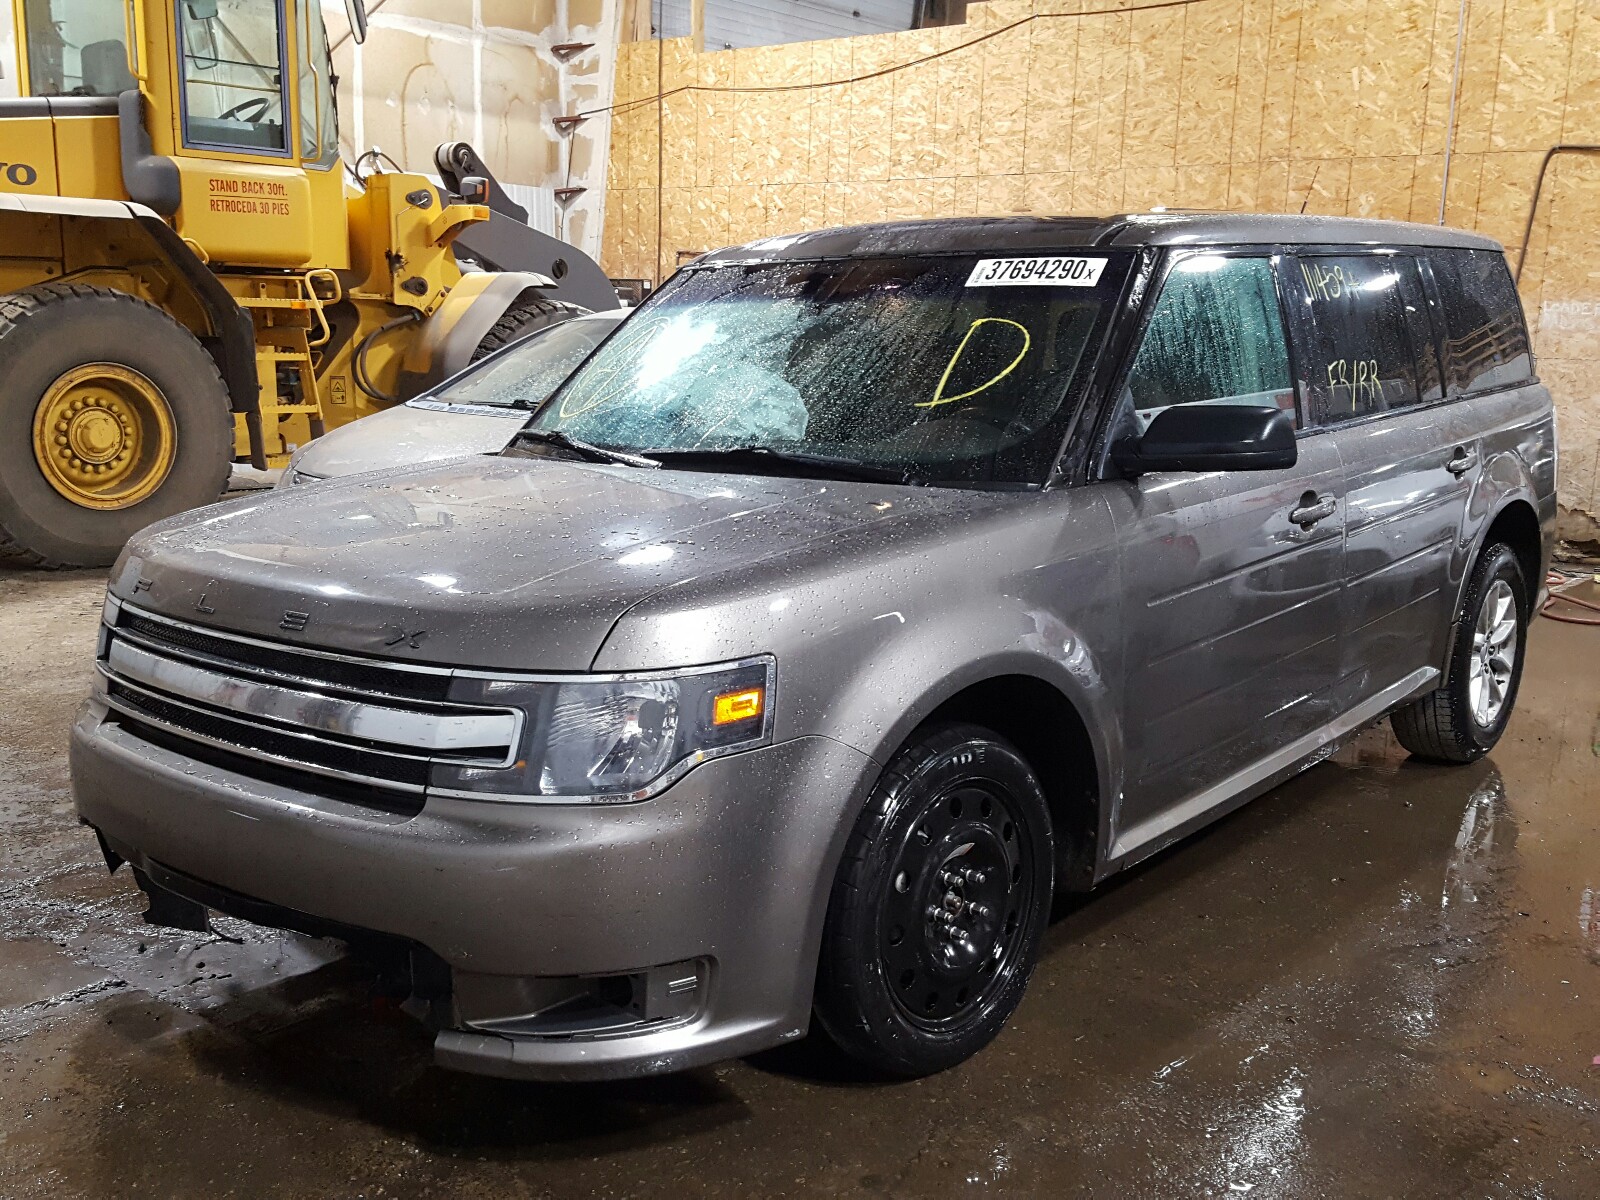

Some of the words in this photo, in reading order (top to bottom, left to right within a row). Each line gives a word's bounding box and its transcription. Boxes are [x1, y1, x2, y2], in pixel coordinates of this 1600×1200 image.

[209, 178, 238, 193] STAND
[241, 181, 265, 195] BACK
[267, 182, 288, 197] 30ft.
[210, 199, 258, 214] RETROCEDA
[259, 202, 270, 215] 30
[272, 202, 290, 216] PIES
